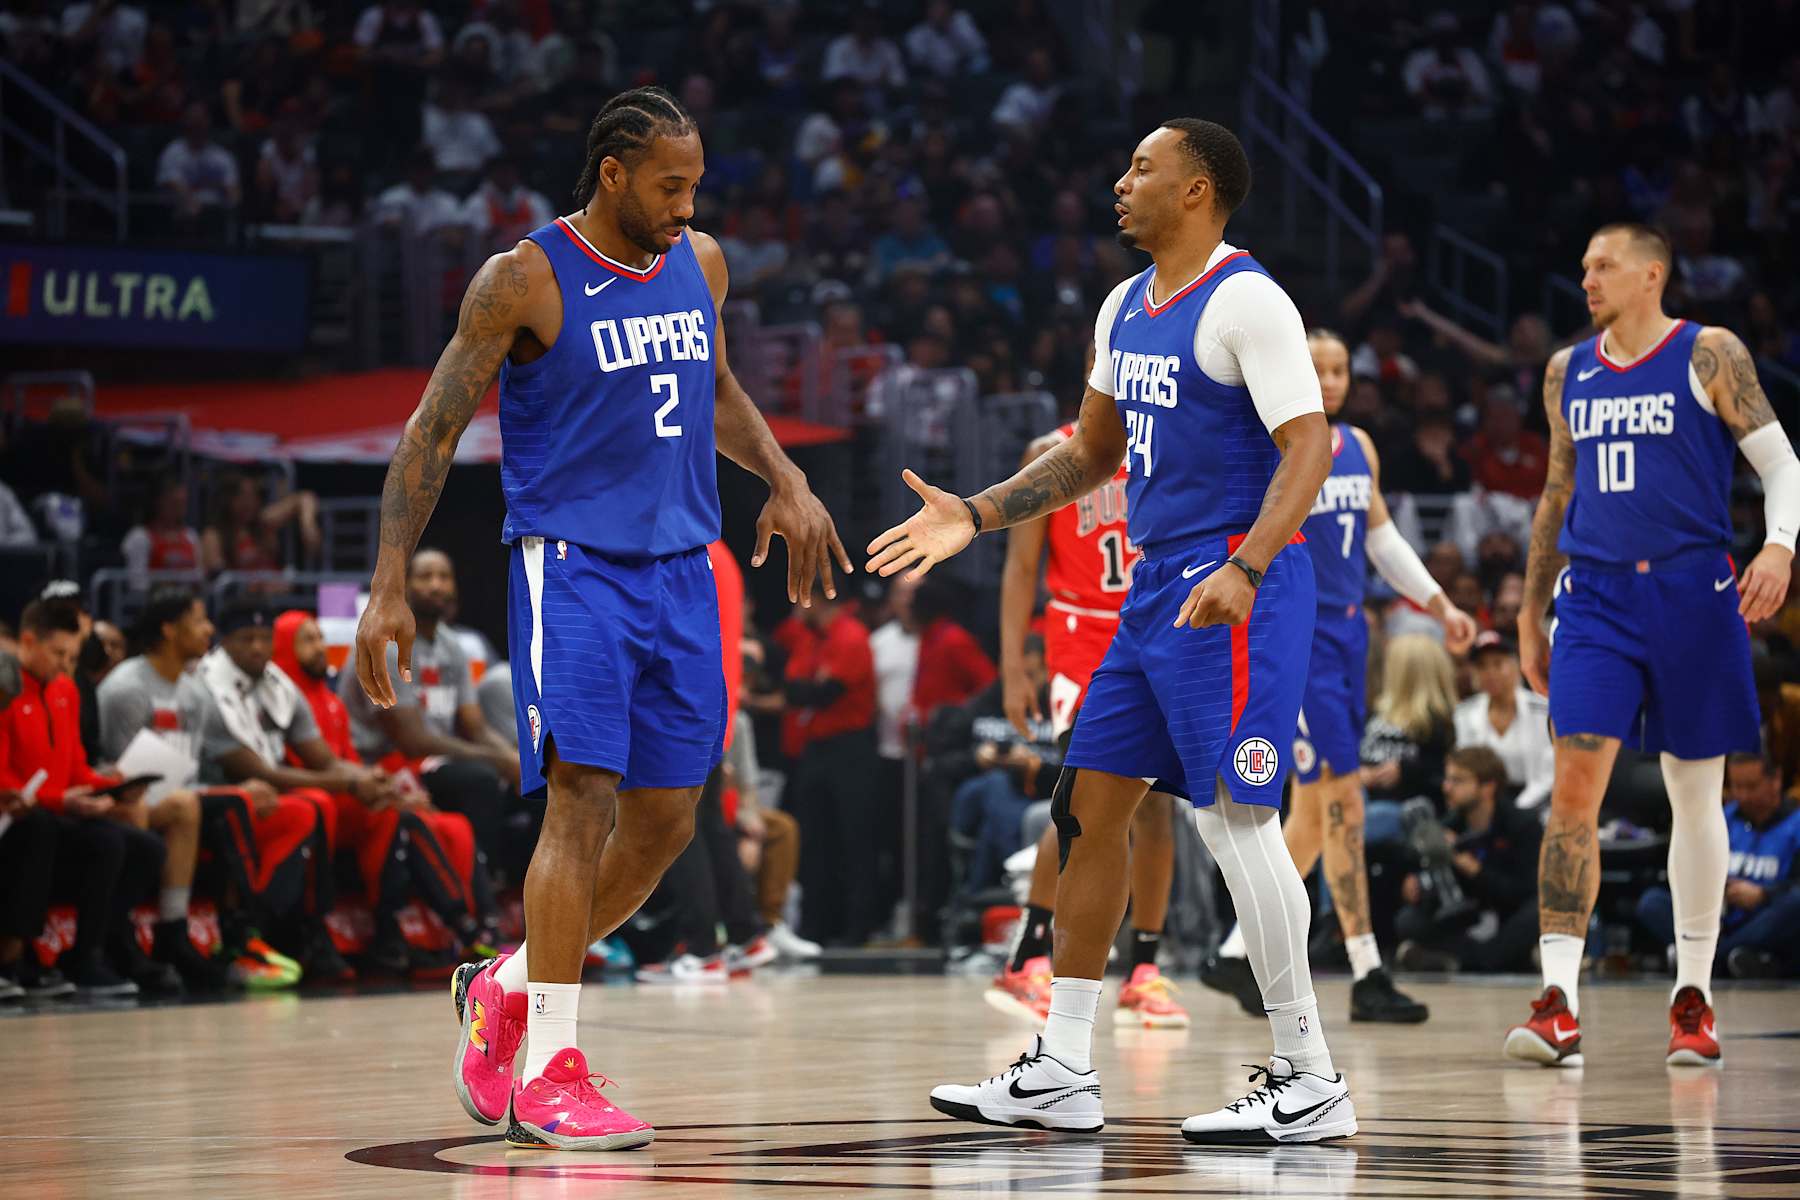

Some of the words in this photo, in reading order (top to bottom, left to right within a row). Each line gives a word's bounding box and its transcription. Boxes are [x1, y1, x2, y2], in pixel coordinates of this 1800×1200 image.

[42, 268, 216, 322] ULTRA
[590, 309, 710, 373] CLIPPERS
[650, 373, 682, 437] 2
[1569, 392, 1675, 442] CLIPPERS
[1126, 410, 1154, 478] 24
[1597, 441, 1635, 493] 10
[1337, 512, 1355, 558] 7
